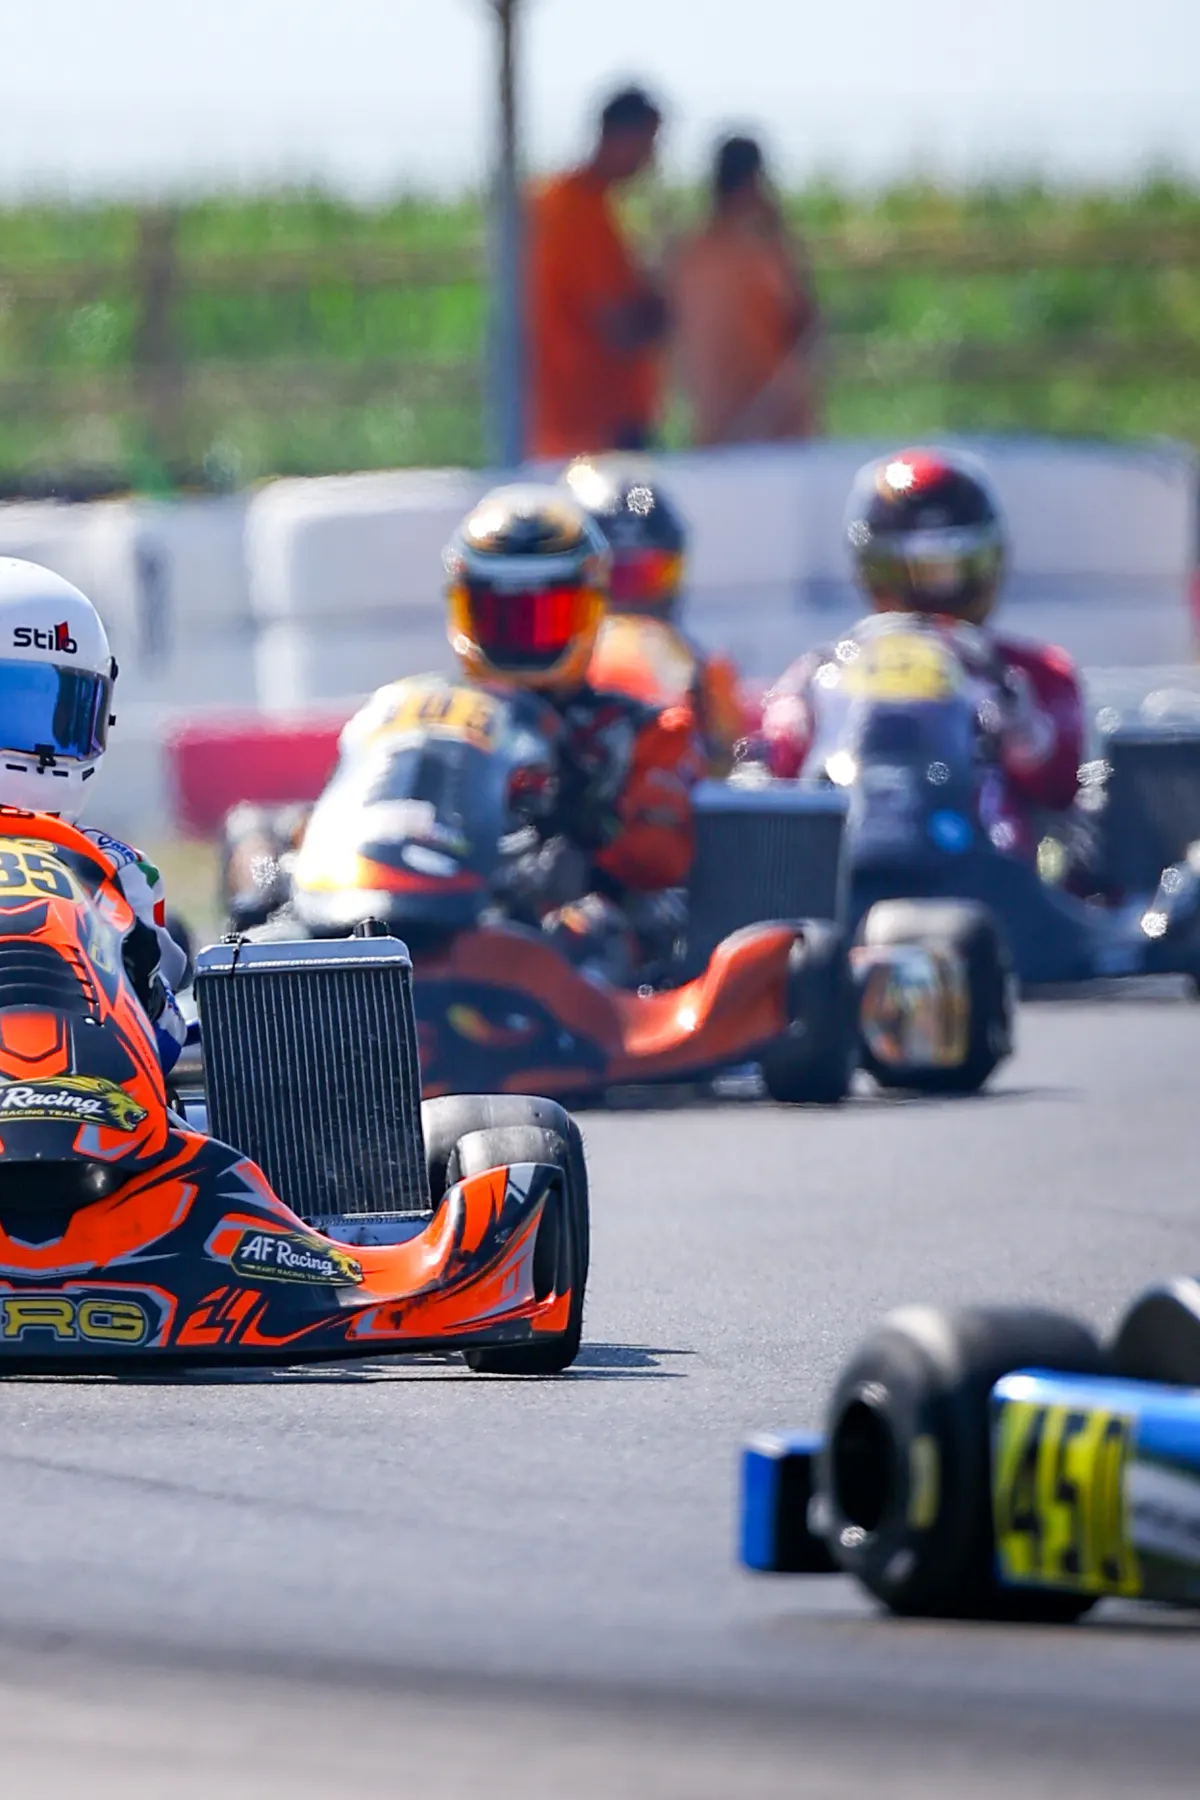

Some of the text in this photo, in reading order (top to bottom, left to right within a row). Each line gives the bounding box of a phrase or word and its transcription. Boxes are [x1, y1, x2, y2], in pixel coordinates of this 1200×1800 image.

[13, 621, 77, 654] Stilo
[0, 1109, 44, 1117] RACING
[48, 1109, 81, 1118] TEAM
[1, 1087, 103, 1113] Racing
[241, 1236, 338, 1275] AF Racing
